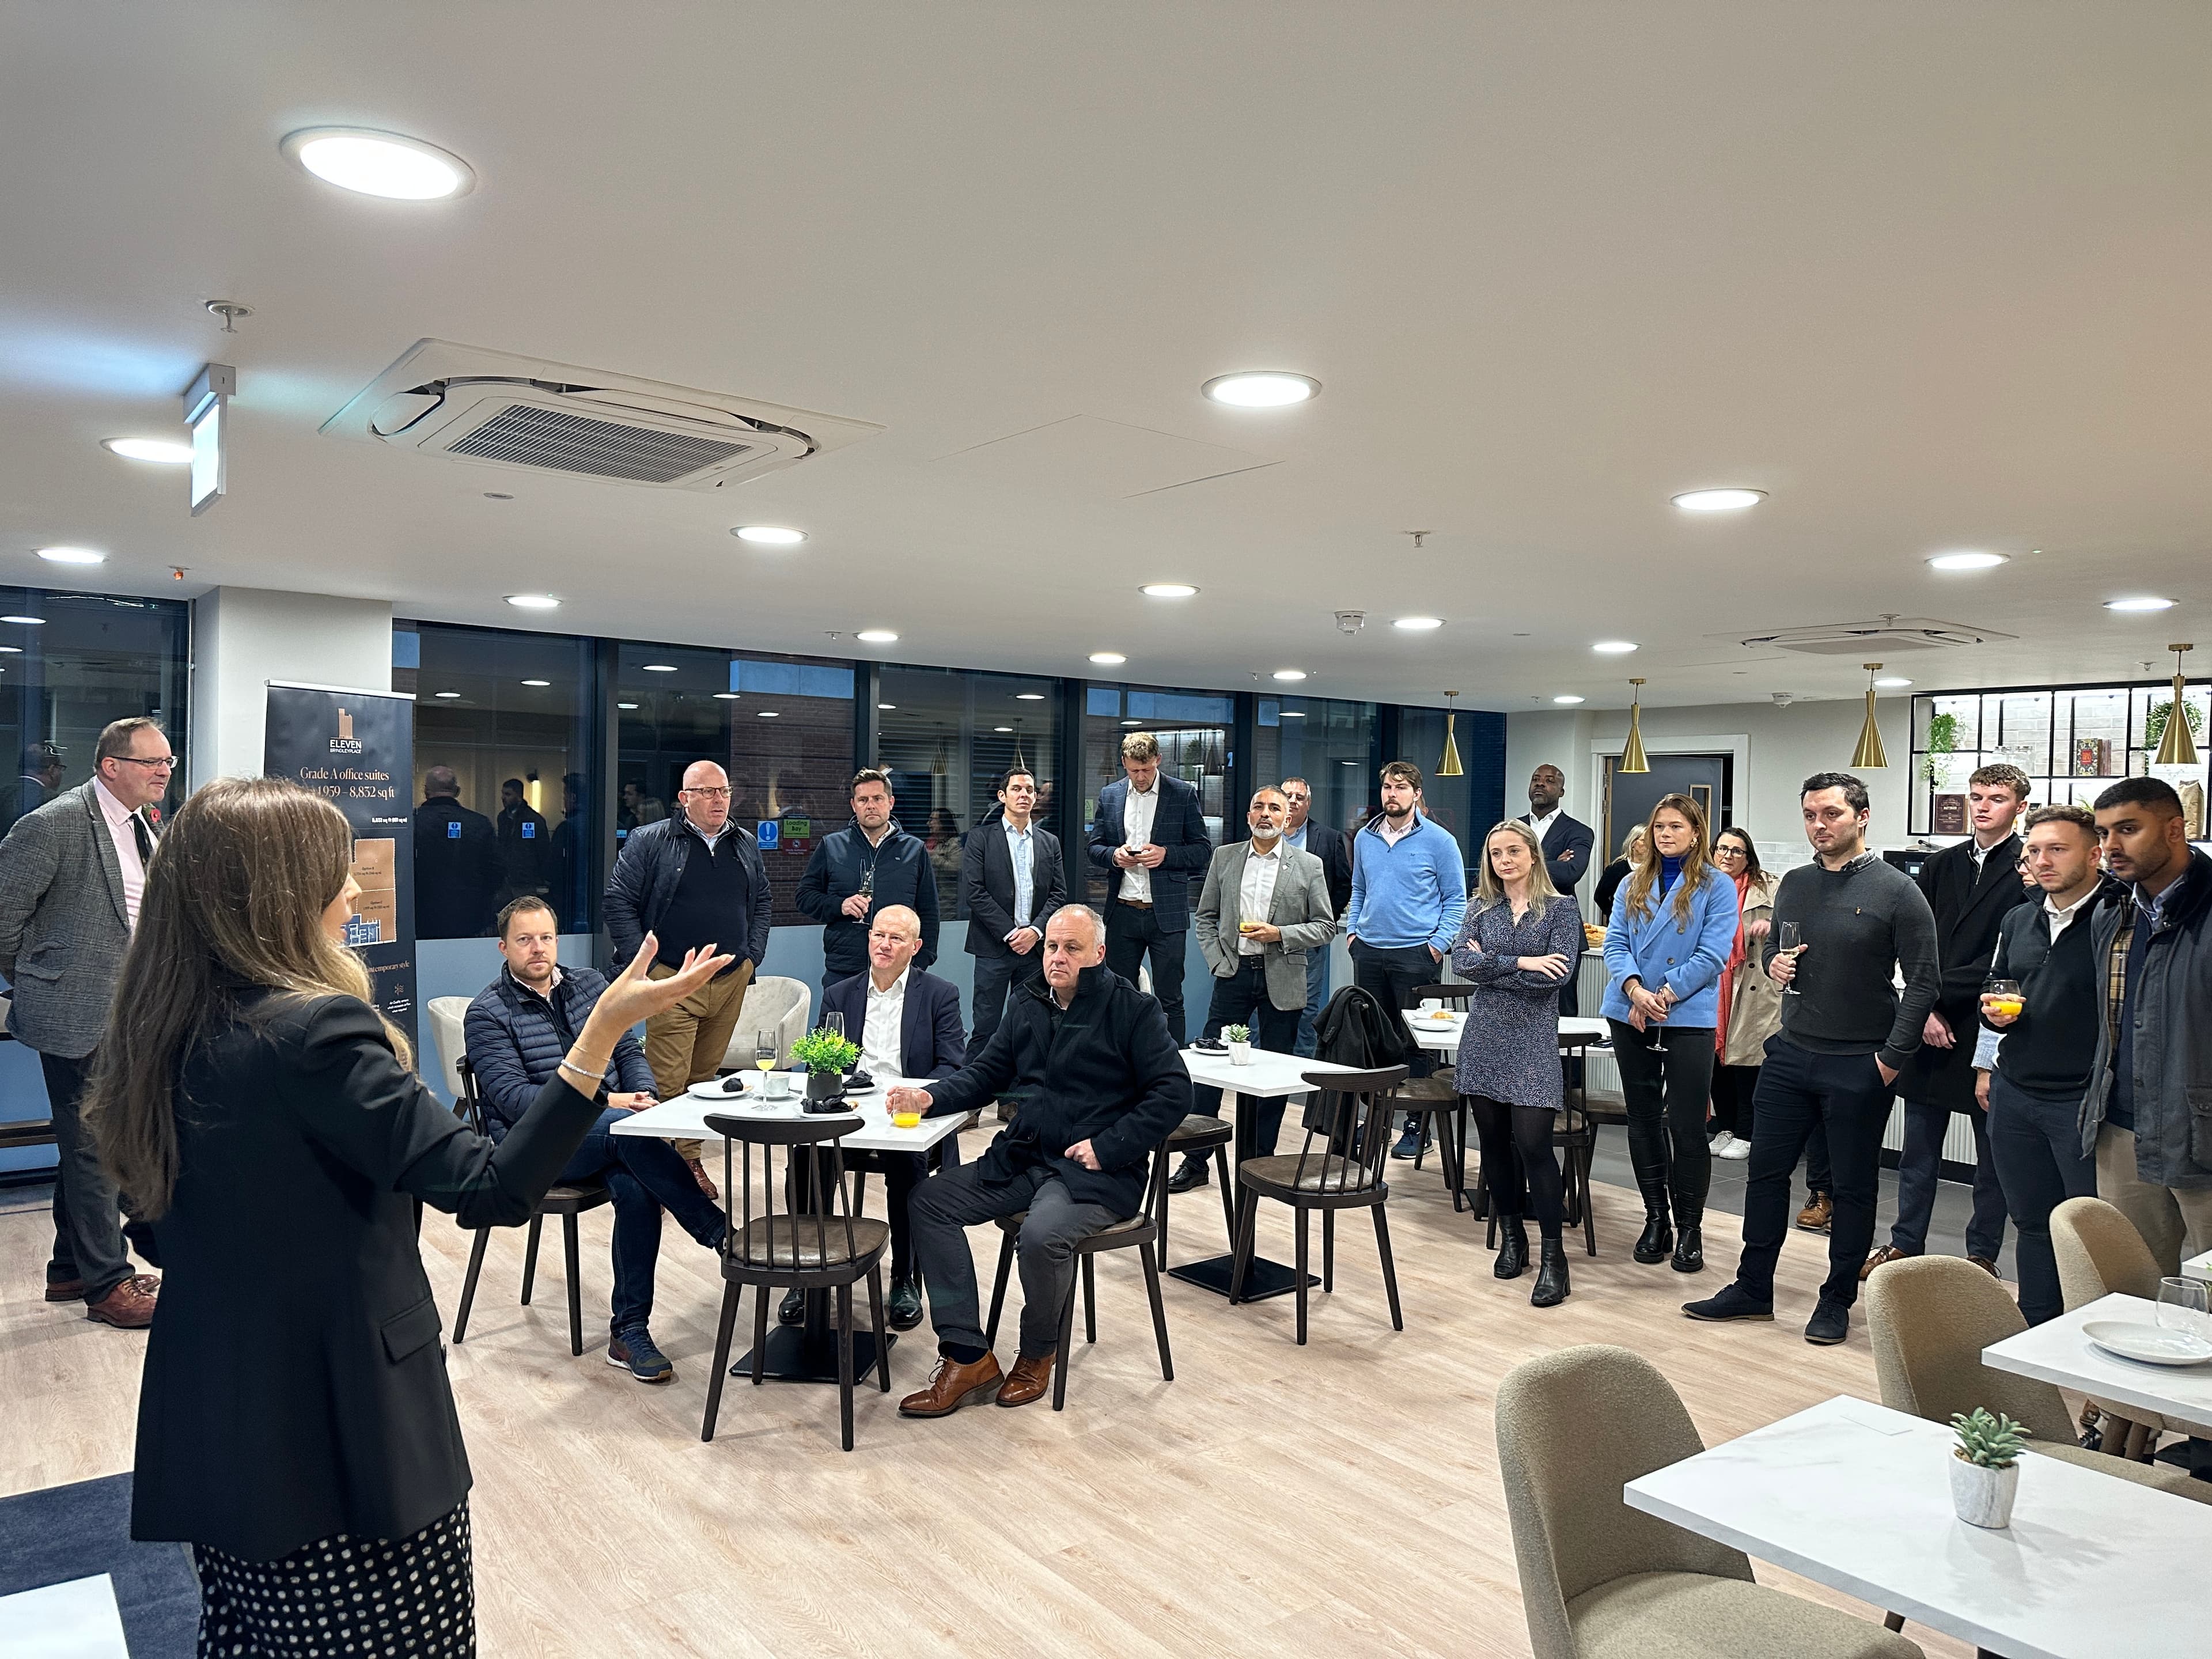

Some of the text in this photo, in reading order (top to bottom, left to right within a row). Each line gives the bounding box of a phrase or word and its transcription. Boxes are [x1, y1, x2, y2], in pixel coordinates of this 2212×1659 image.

[330, 740, 362, 749] ELEVEN
[300, 767, 389, 781] Grade A office suites
[350, 786, 376, 799] 8,832
[377, 789, 388, 801] sq
[388, 786, 395, 798] ft
[367, 964, 398, 973] ontemporary
